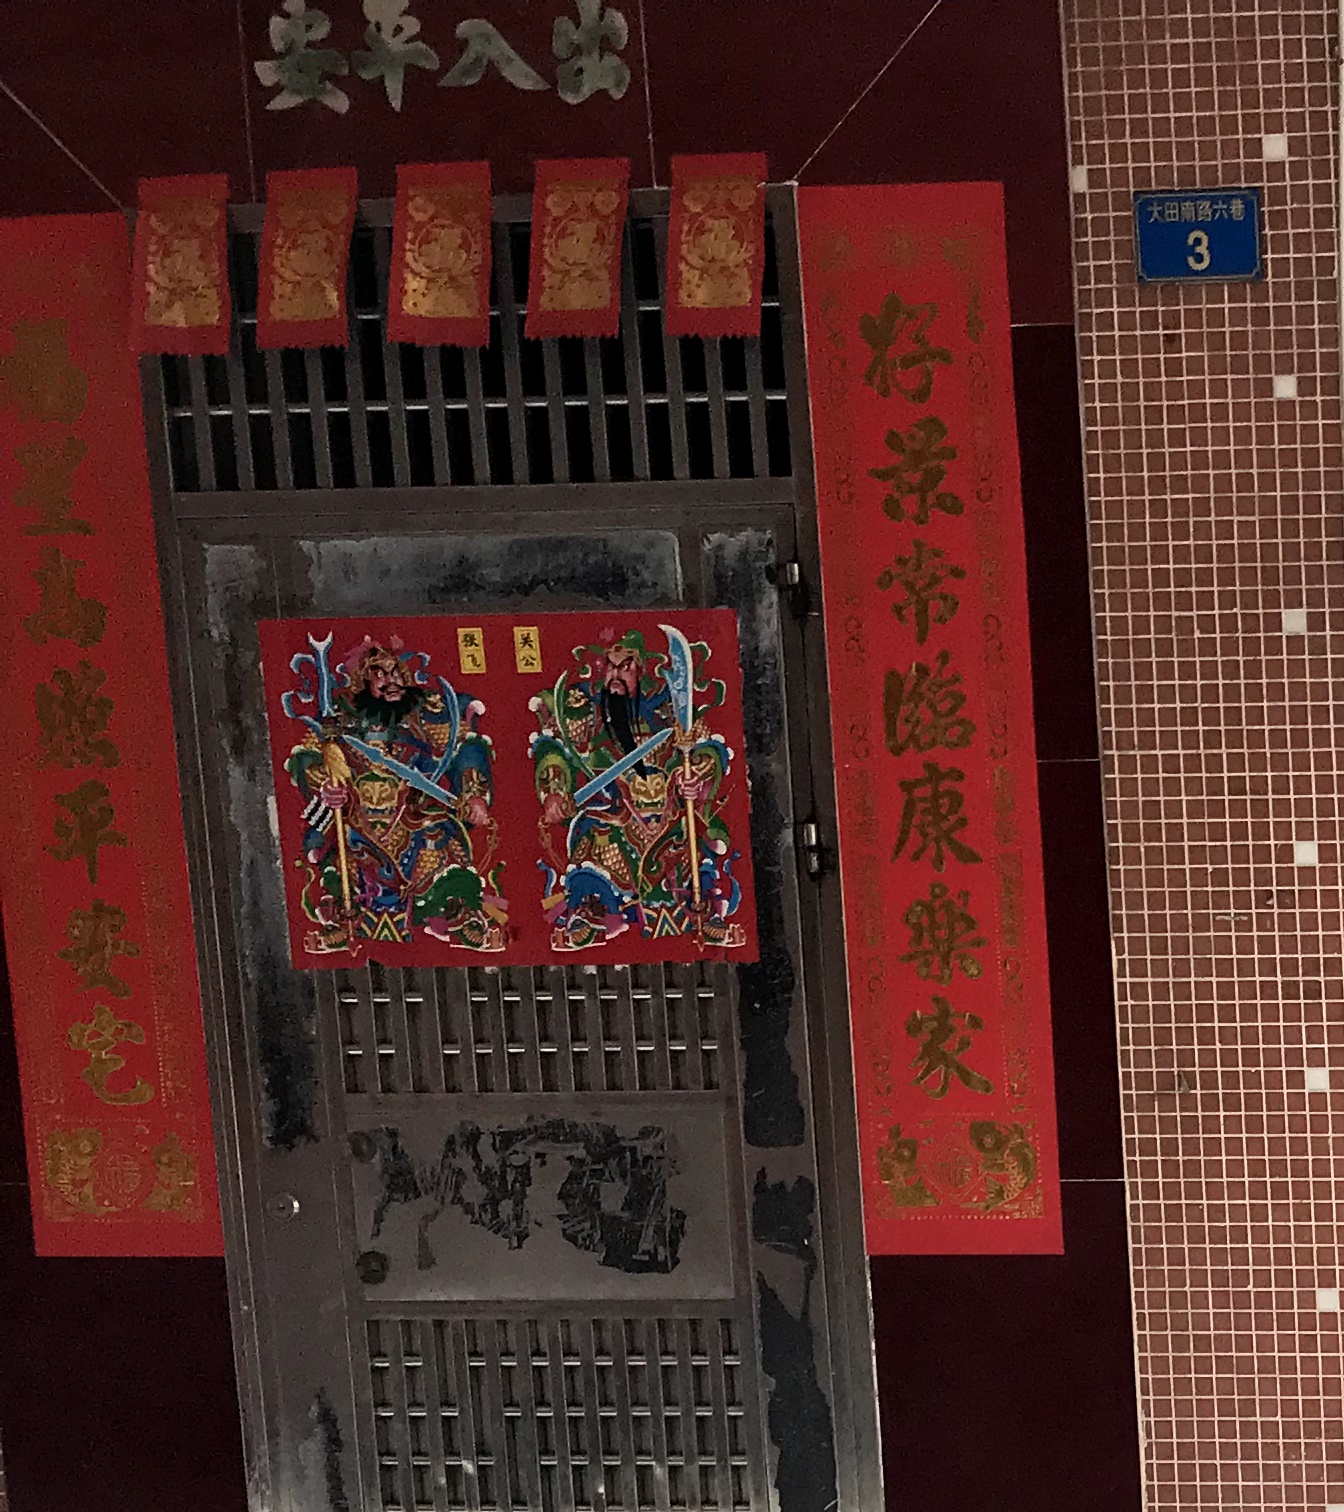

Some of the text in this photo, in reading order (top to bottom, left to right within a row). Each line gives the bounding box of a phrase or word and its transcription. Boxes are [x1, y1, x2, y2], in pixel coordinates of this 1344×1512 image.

[1147, 199, 1245, 223] 大田南路六巷
[1187, 230, 1211, 271] 3
